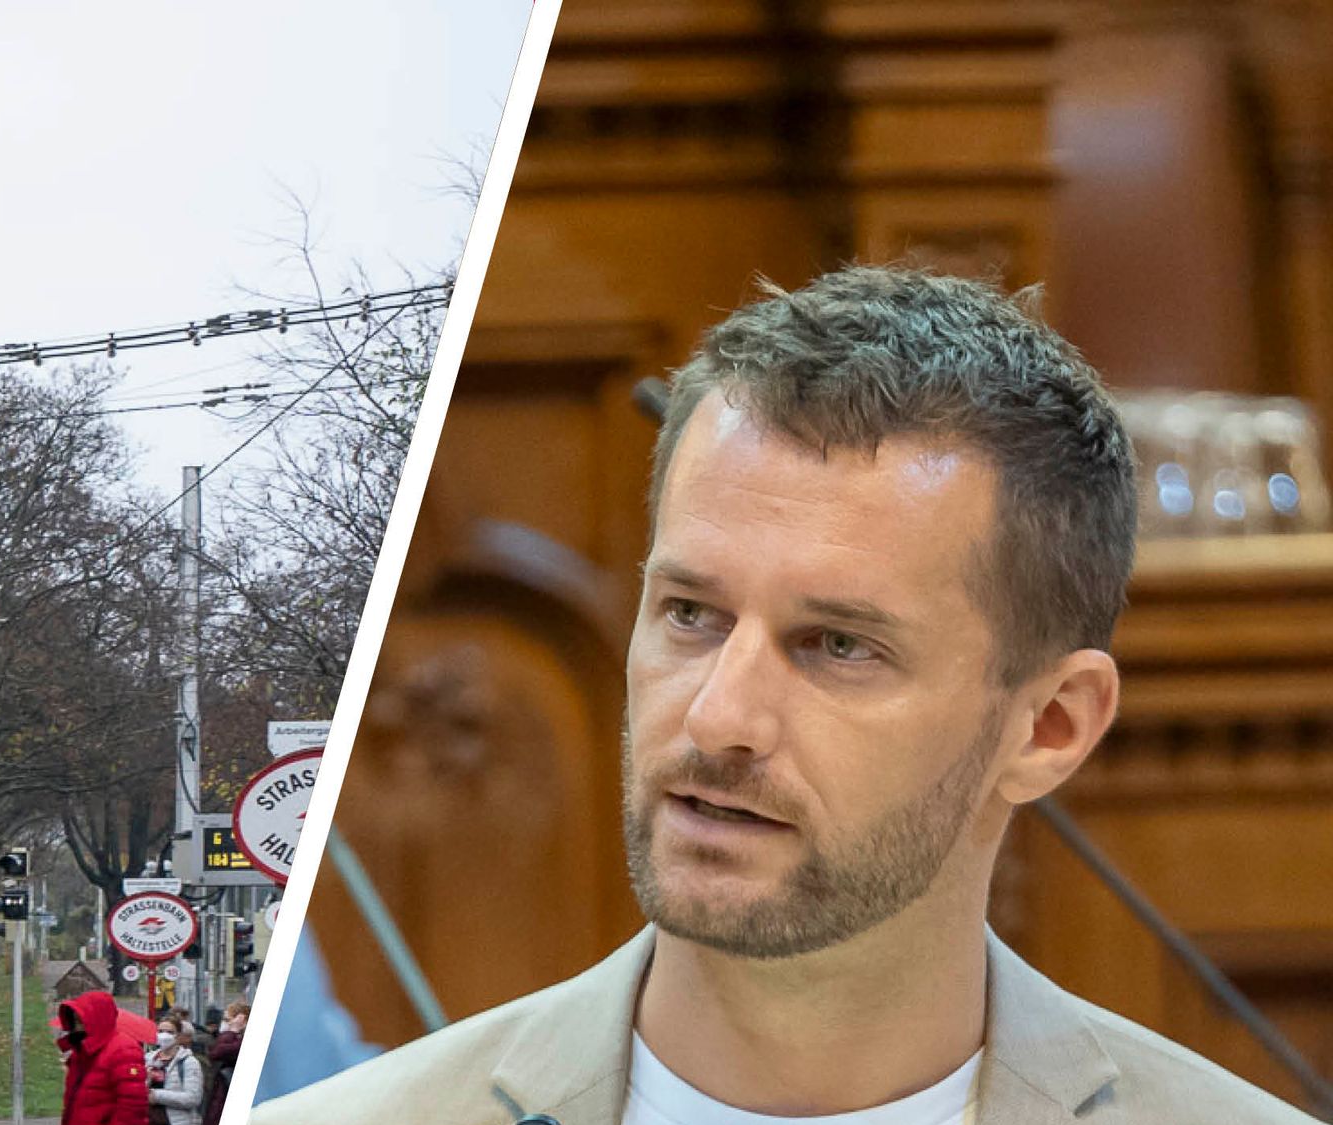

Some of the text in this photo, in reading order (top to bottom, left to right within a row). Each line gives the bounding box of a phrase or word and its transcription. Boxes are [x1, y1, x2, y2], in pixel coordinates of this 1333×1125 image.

[256, 768, 319, 811] STRAS
[118, 900, 187, 922] STRASSENBAHN
[120, 931, 183, 952] HALTESTELLE
